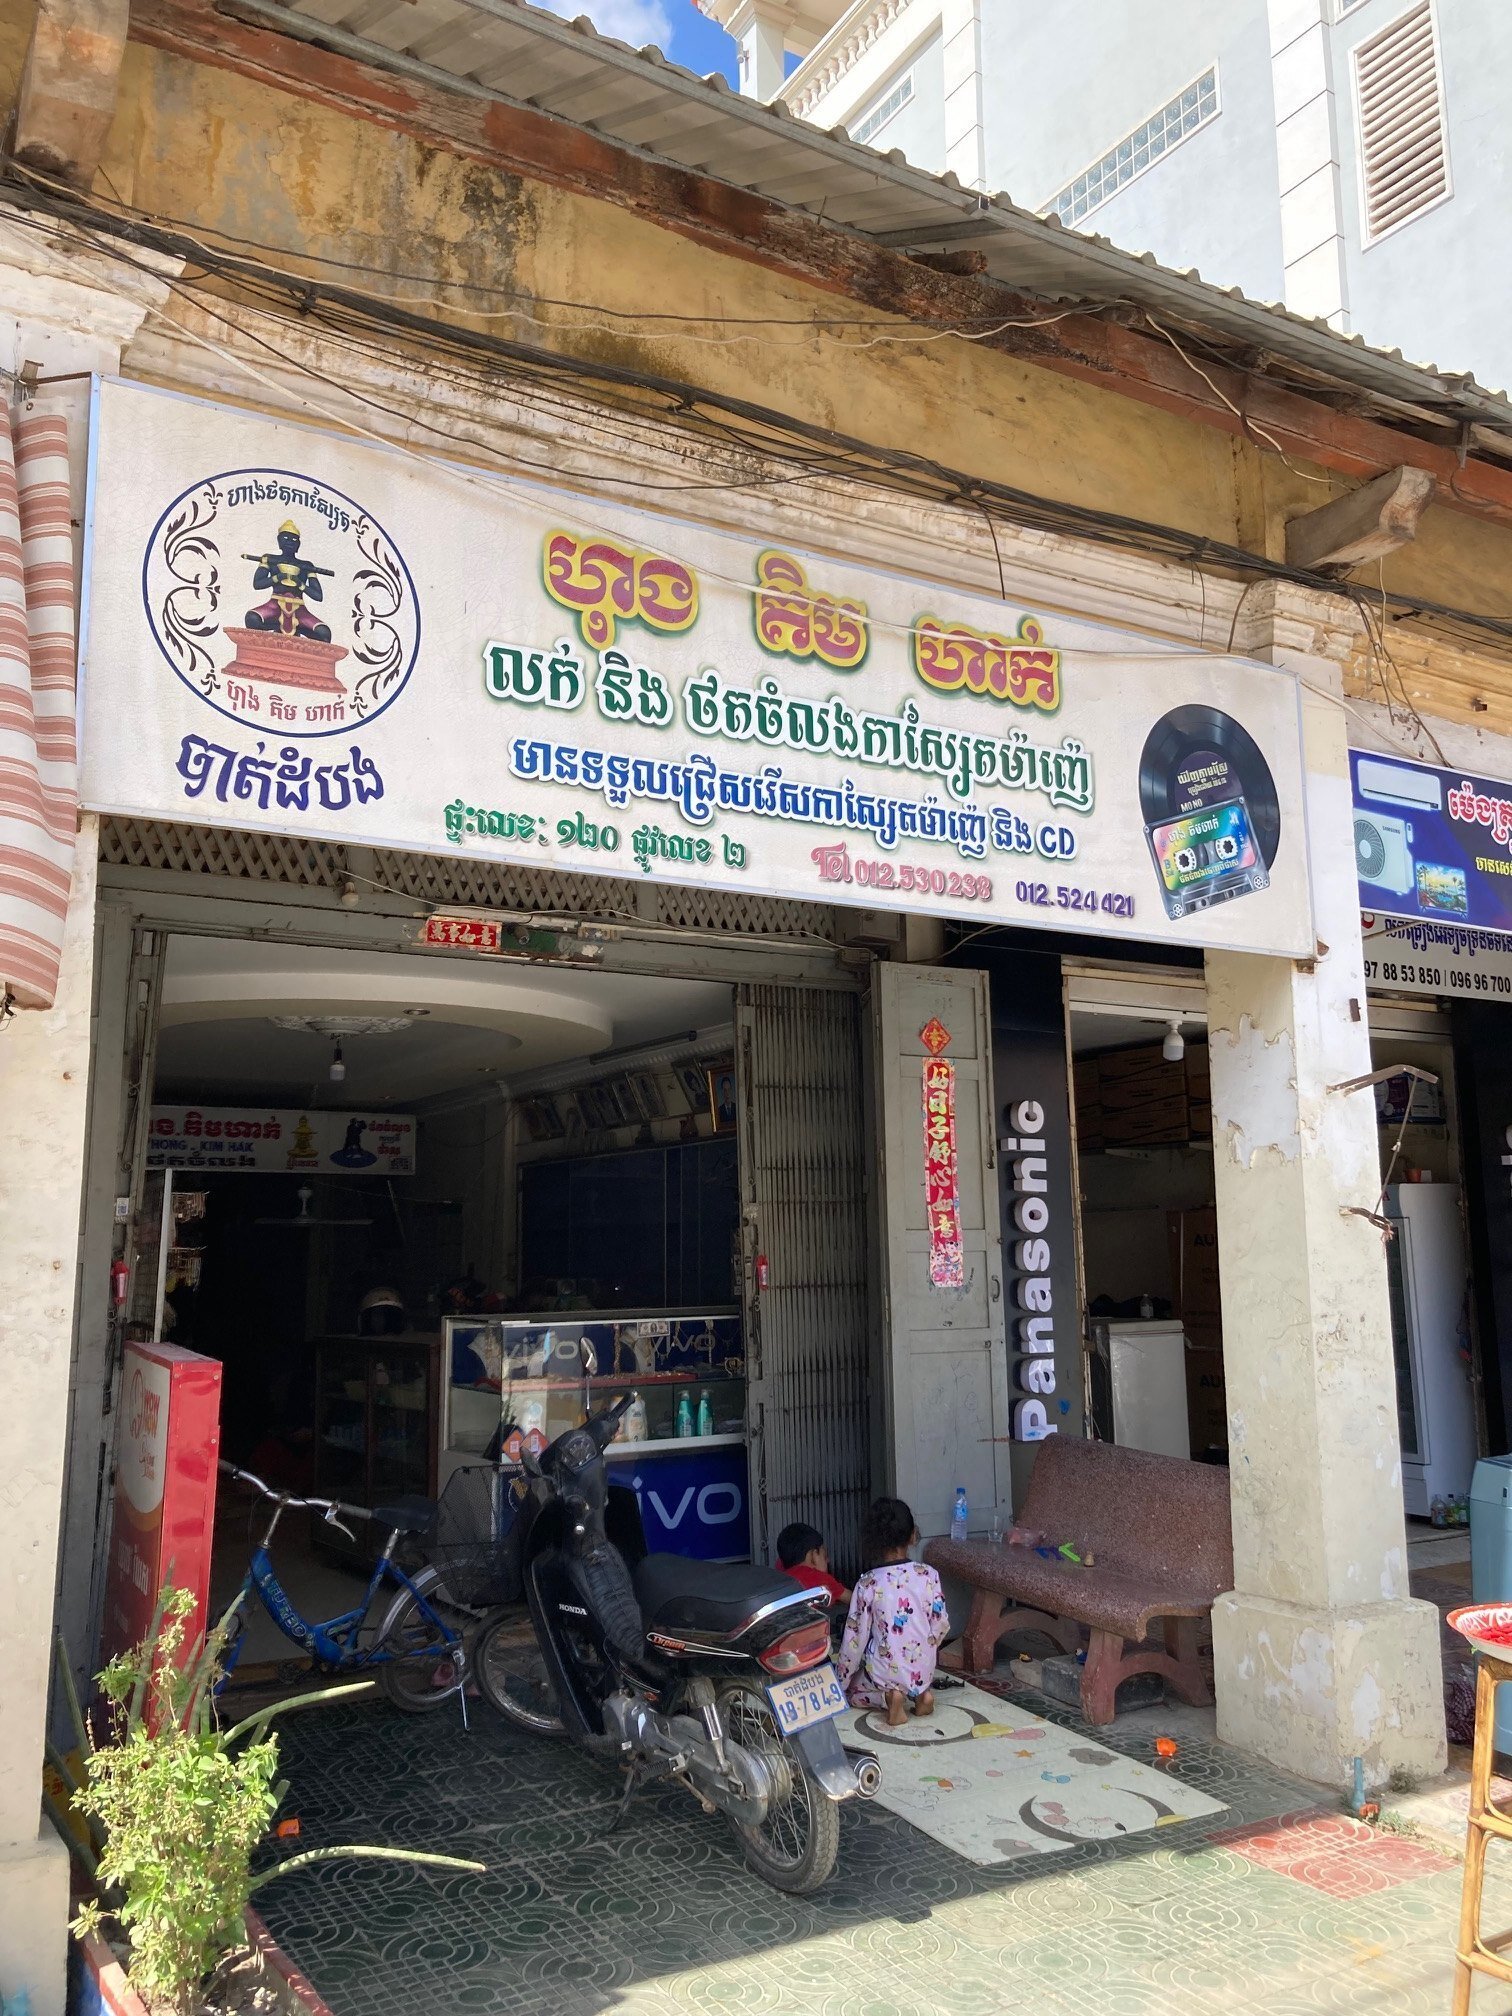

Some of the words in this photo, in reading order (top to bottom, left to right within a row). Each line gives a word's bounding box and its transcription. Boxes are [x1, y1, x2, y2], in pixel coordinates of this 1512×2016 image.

[489, 643, 579, 704] លក់
[600, 650, 668, 719] និង
[269, 694, 298, 721] គិម
[175, 733, 385, 812] បាត់ដំបង
[556, 810, 620, 852] ១២០
[721, 832, 748, 869] ២
[992, 807, 1032, 851] និង
[1039, 827, 1076, 856] CD
[948, 874, 992, 900] 238
[1099, 892, 1135, 917] 421
[1383, 962, 1398, 982] 88
[1400, 964, 1415, 983] 53
[1419, 967, 1441, 987] 850
[1450, 970, 1472, 990] 096
[1474, 974, 1488, 992] 96
[1003, 1098, 1058, 1442] Panasonic
[631, 1476, 742, 1530] ivo
[558, 1603, 588, 1616] HONDA
